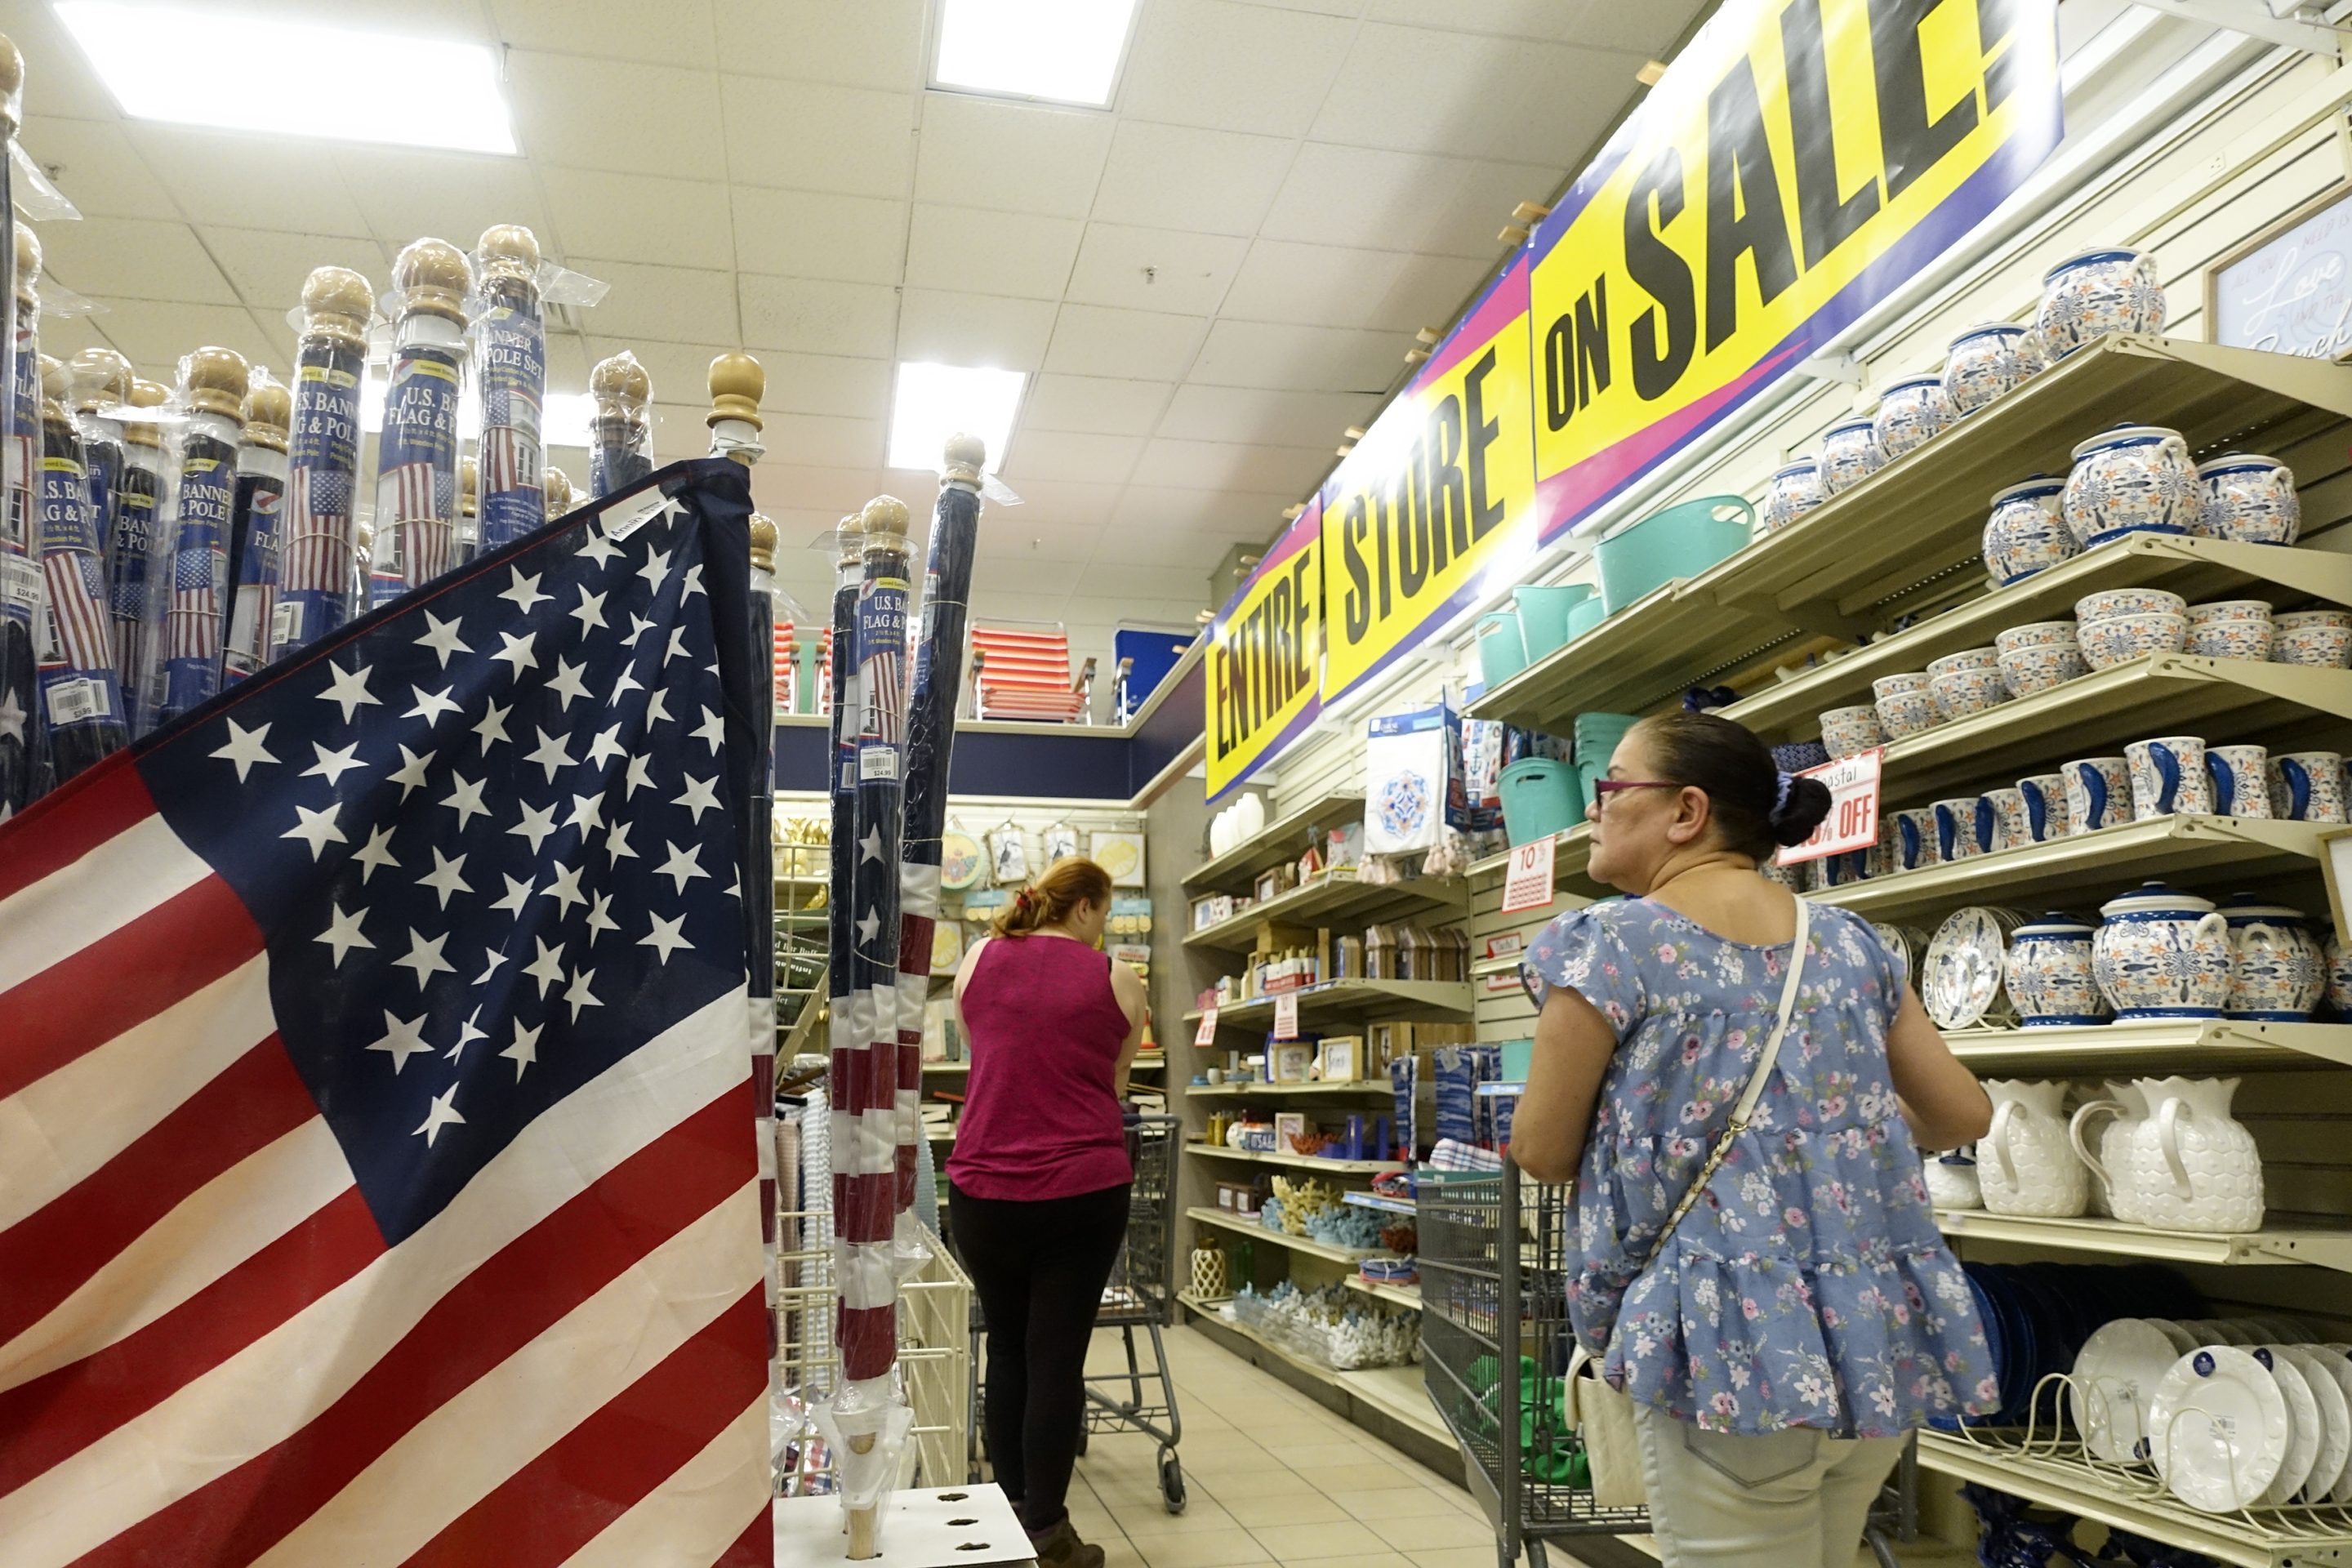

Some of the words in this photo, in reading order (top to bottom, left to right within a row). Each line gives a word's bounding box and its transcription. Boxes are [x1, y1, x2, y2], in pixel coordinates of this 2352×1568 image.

[2243, 246, 2341, 336] Love
[523, 354, 542, 380] SET
[406, 386, 436, 408] U.S.
[308, 416, 323, 434] &
[388, 408, 431, 425] FLAG
[434, 412, 446, 430] &
[65, 505, 79, 522] &
[188, 499, 225, 522] POLE
[1217, 548, 1311, 762] ENTIRE
[1343, 346, 1505, 645] STORE
[1544, 272, 1611, 434] ON
[611, 516, 642, 537] Annin
[875, 595, 893, 611] U.S.
[863, 613, 890, 630] FLAG
[892, 614, 901, 628] &
[1839, 794, 1873, 839] OFF
[1520, 845, 1535, 871] 10
